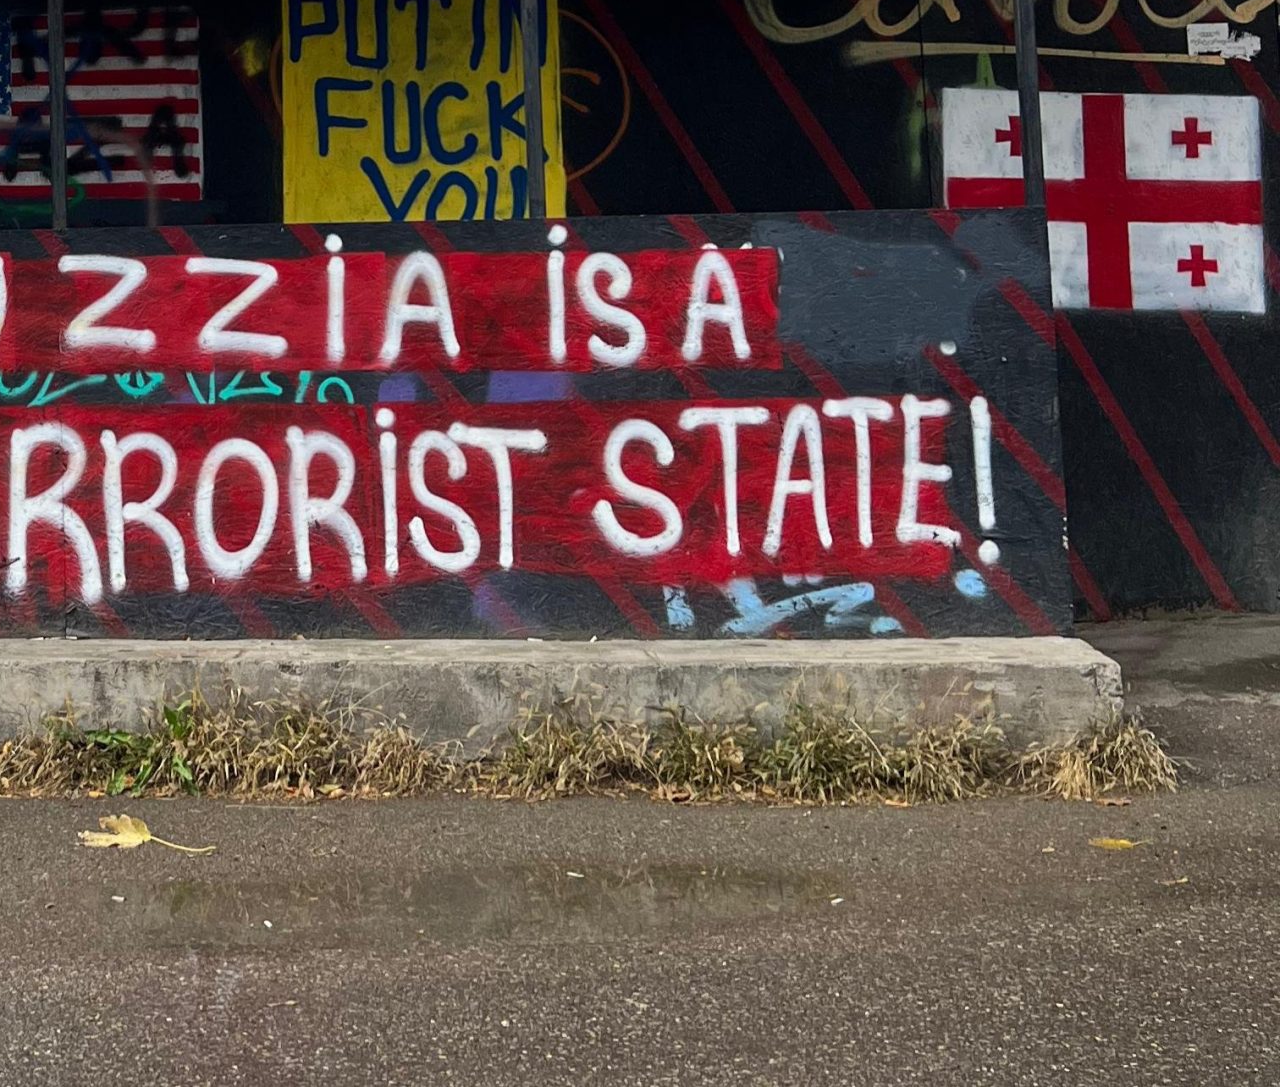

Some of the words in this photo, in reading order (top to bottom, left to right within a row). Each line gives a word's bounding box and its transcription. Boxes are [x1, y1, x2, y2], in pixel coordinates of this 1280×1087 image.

[314, 77, 551, 165] FUCK
[360, 155, 529, 221] YOU
[680, 247, 752, 363] A
[591, 393, 1003, 566] STATE!
